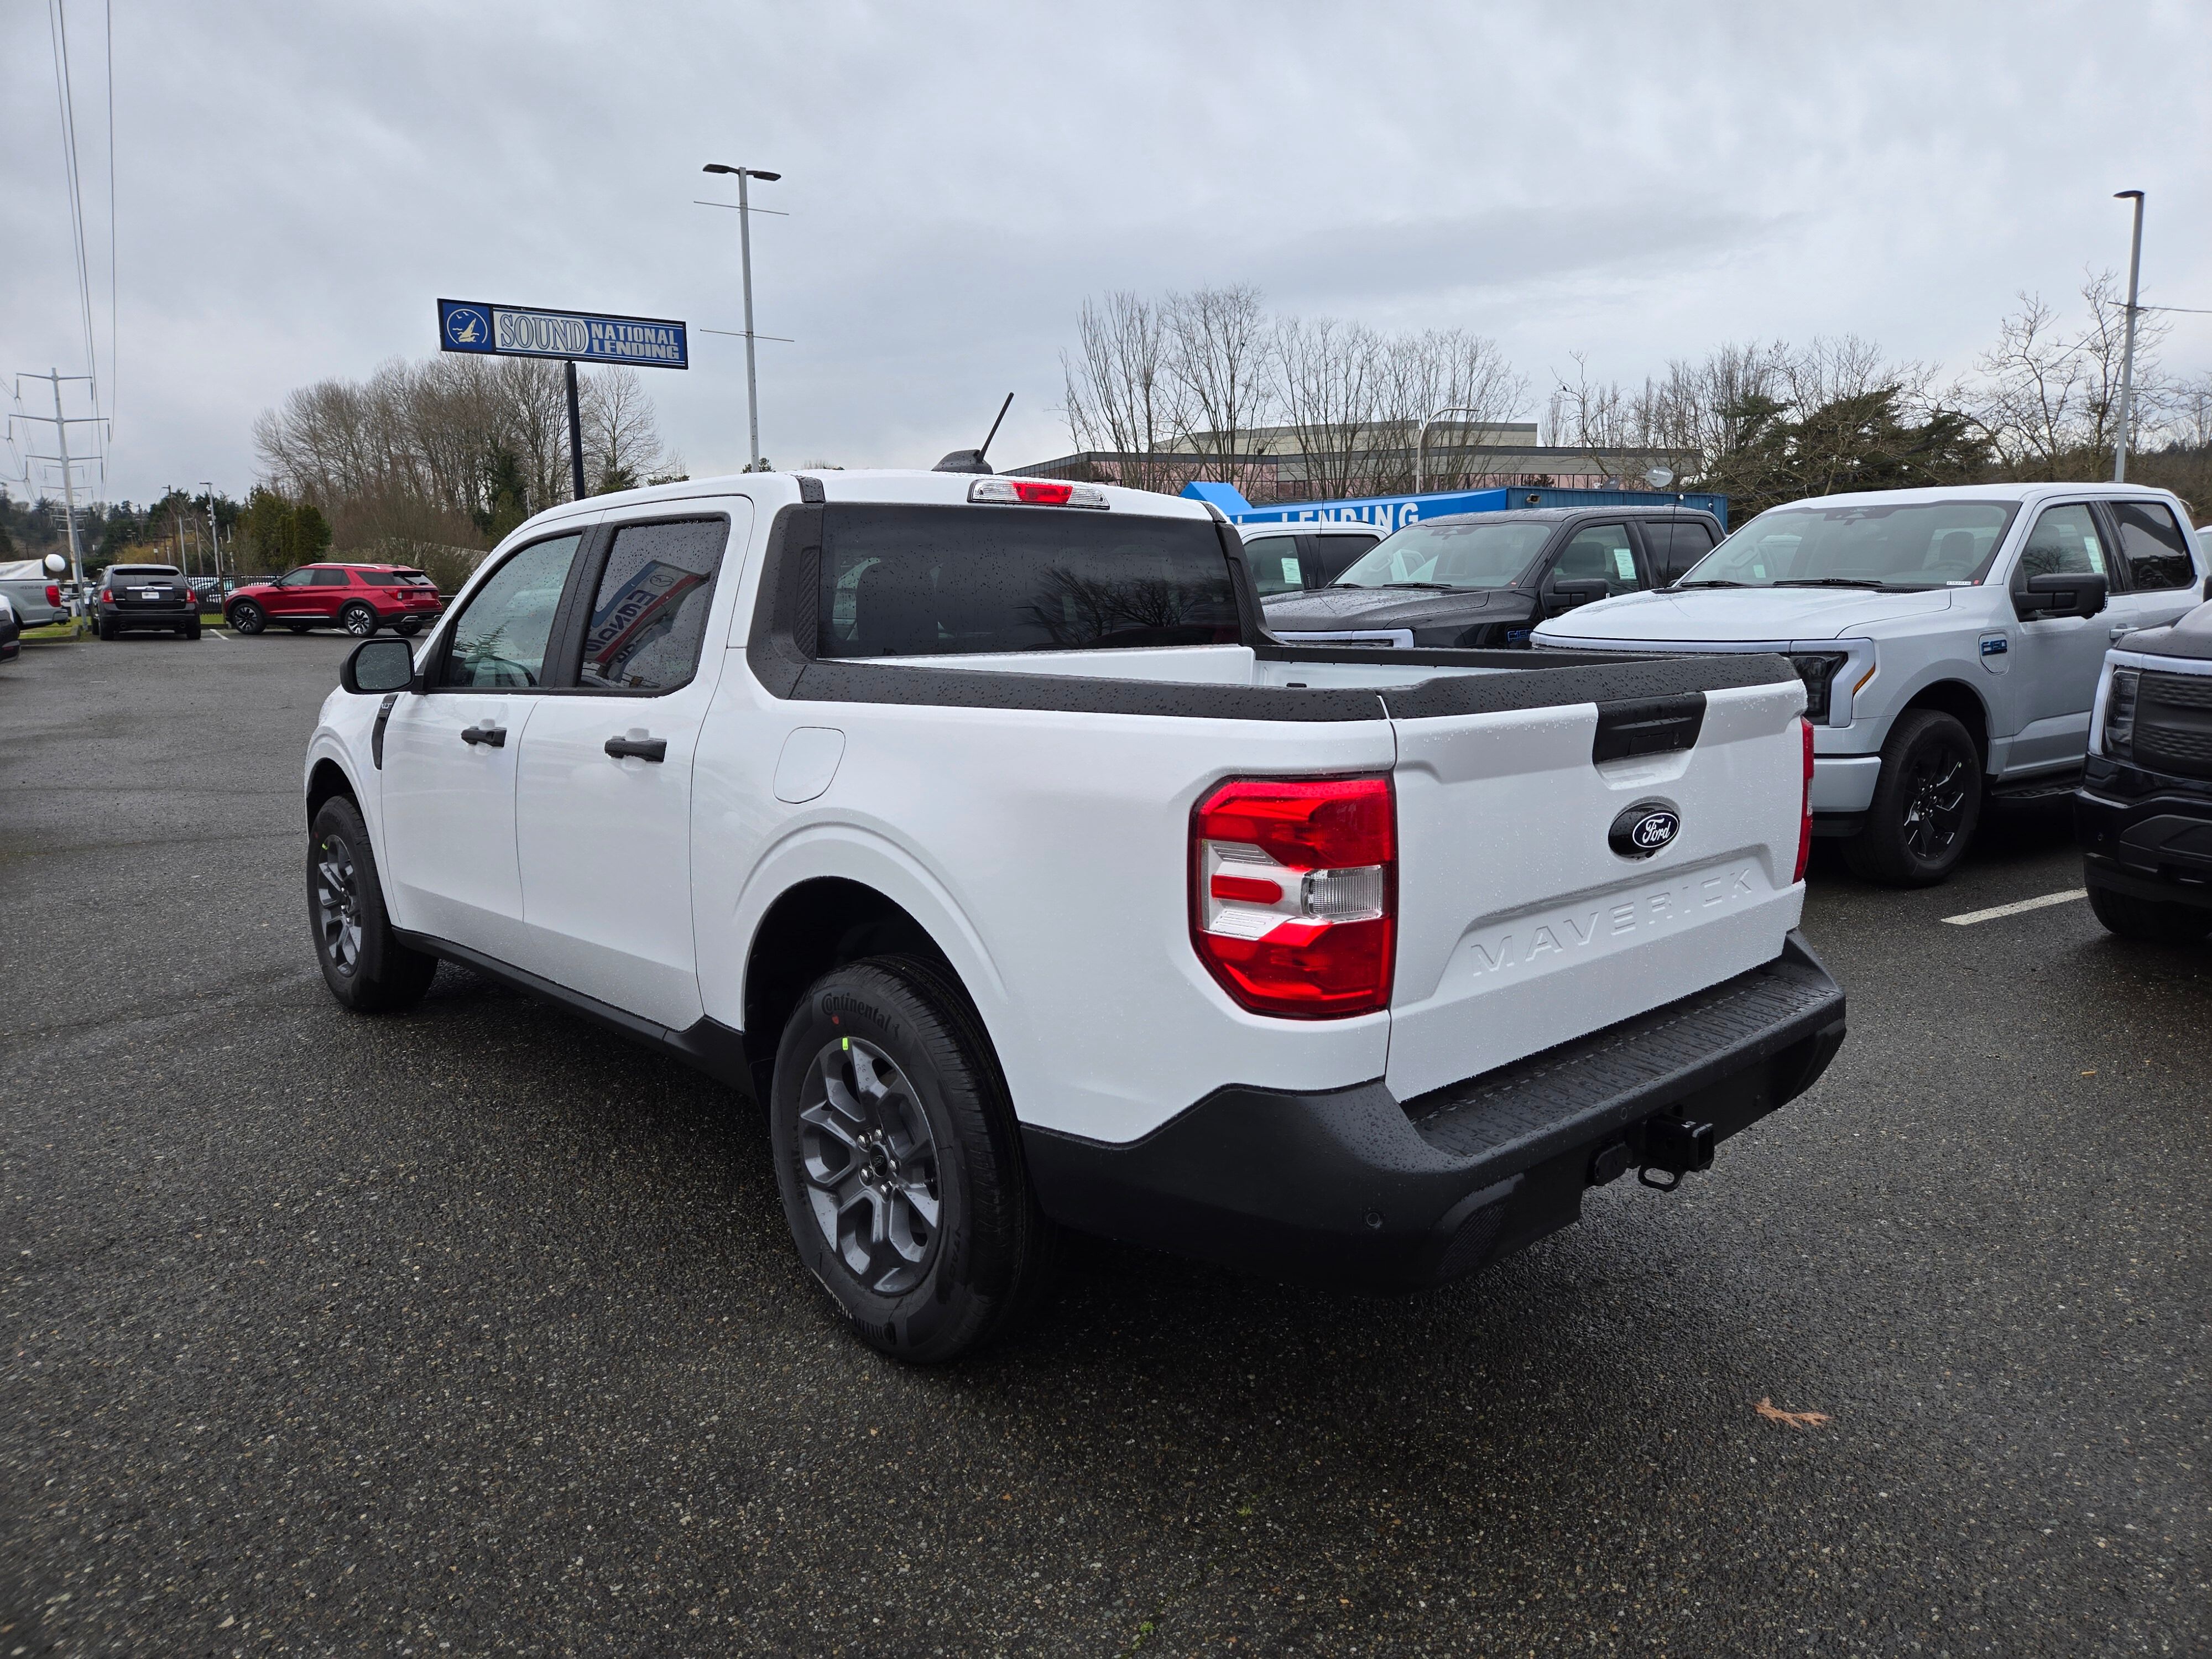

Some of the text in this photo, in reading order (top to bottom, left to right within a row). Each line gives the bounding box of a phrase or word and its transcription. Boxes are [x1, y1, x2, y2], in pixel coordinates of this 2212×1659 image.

[499, 314, 587, 352] SOUND
[591, 323, 678, 346] NATIONAL
[592, 339, 680, 360] LENDING
[1642, 818, 1671, 843] Ford
[1471, 868, 1752, 977] MAVERICK
[821, 992, 892, 1032] Continental
